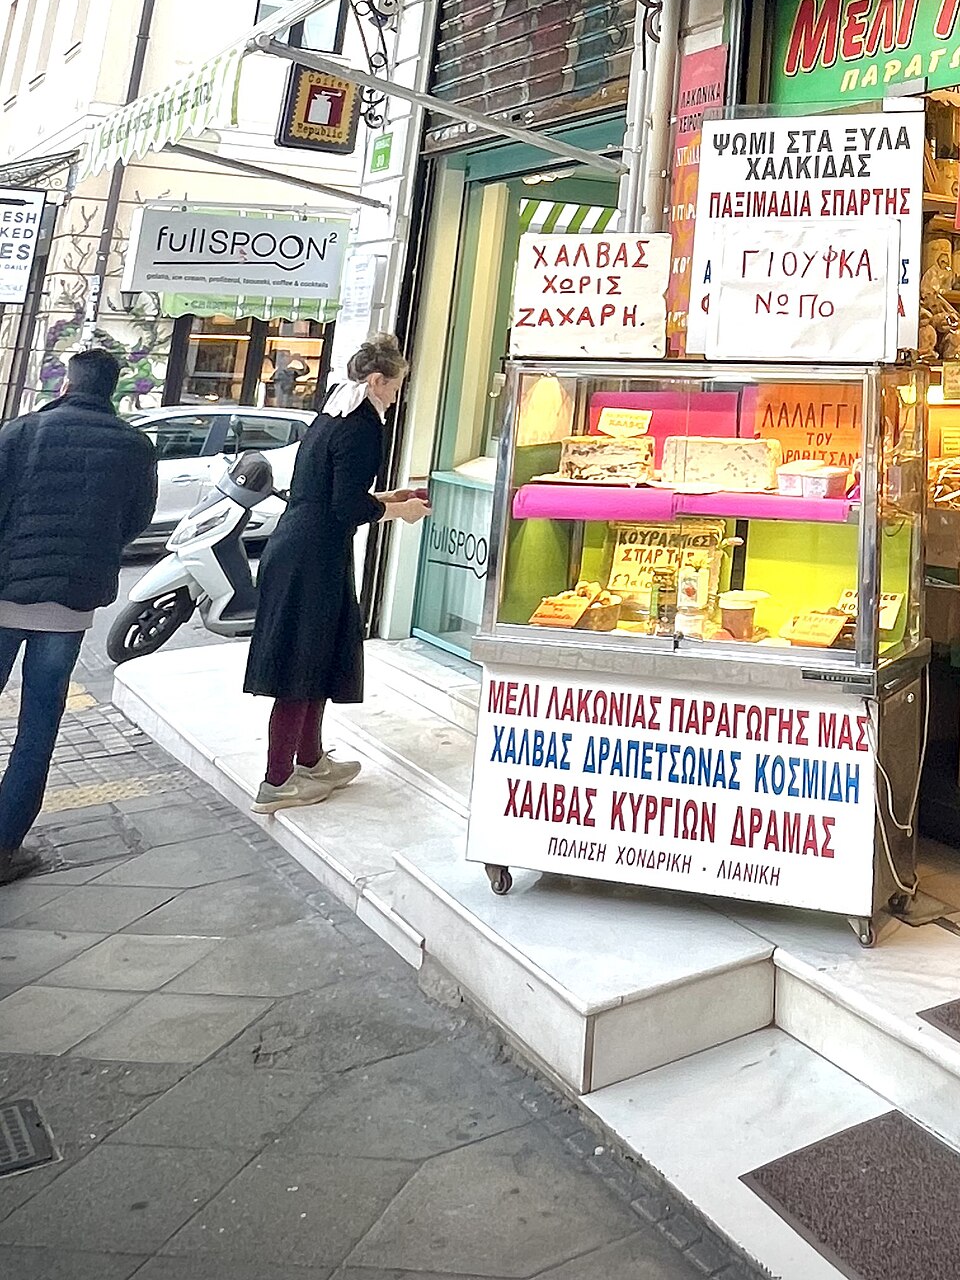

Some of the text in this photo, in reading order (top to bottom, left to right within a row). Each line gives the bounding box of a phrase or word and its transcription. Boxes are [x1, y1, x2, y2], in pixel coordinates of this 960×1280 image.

[296, 122, 343, 139] Republic
[712, 131, 775, 157] ΨΩΜΙ
[787, 130, 831, 153] ΣΤΑ
[844, 126, 911, 151] ΞΥΛΑ
[745, 154, 871, 181] ΧΑΛΚΙΔΑΣ
[0, 211, 37, 224] ESH
[709, 190, 812, 219] ΠΑΞΙΜΑΔΙΑ
[820, 187, 911, 217] ΣΠΑΡΤΗΣ
[4, 263, 28, 271] DAILY
[533, 240, 651, 269] ΧΑΛΒΑΣ
[542, 275, 622, 296] ΧΩΡΙΣ
[514, 303, 646, 328] ΖΑΧΑΡΗ.
[806, 432, 832, 446] ΤΟΥ
[430, 522, 487, 565] fullSPOO
[487, 680, 869, 753] ΜΕΛΙ ΛΑΚΩΝΙΑΣ ΠΑΡΑΓΩΓΗΣ ΜΑΣ
[490, 725, 859, 804] ΧΑΛΒΑΣ ΔΡΑΠΕΤΣΩΝΑΣ ΚΟΣΜΙΔΗ
[504, 778, 836, 858] ΧΑΛΒΑΣ ΚΥΡΓΙΩΝ ΔΡΑΜΑΣ
[547, 837, 606, 862] ΠΩΛΗΣΗ
[615, 845, 692, 874] ΧΟΝΔΡΙΚΗ
[716, 859, 780, 887] ΛΙΑΝΙΚΗ
